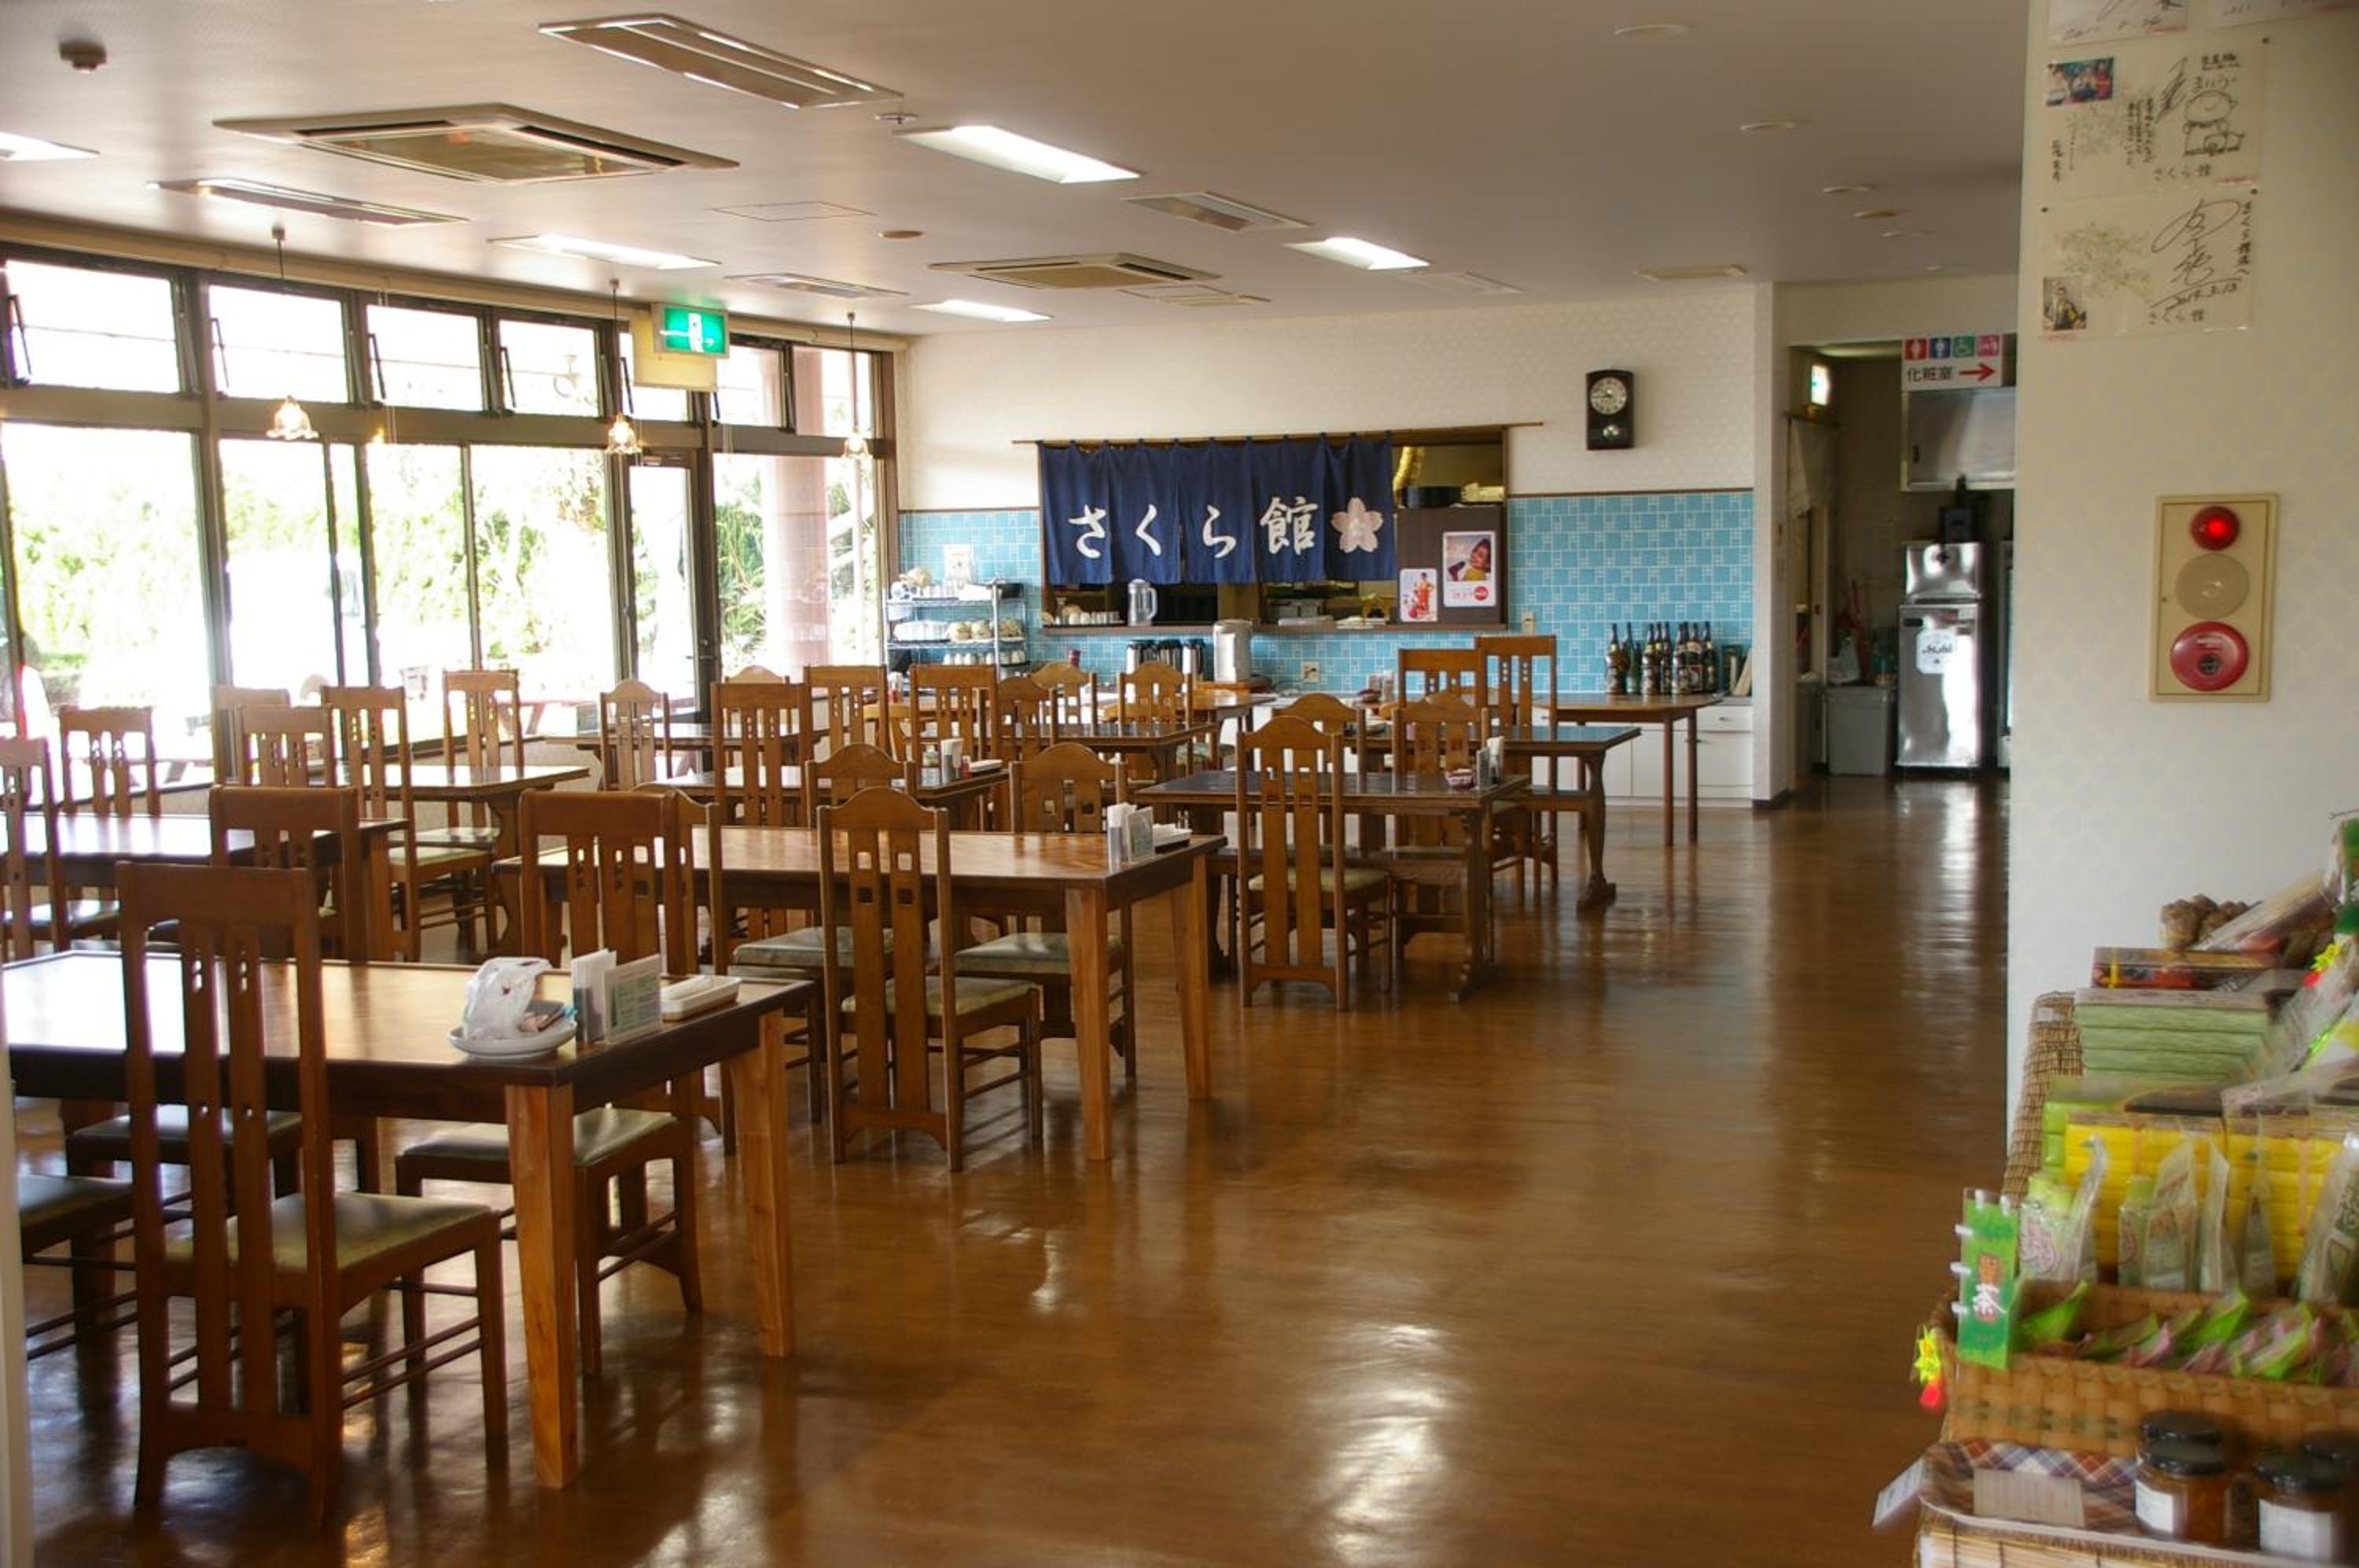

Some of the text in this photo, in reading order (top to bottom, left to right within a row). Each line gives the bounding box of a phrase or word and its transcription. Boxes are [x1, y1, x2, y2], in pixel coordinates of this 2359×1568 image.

[1907, 365, 1953, 383] 化粧室
[1068, 495, 1318, 559] さくら館
